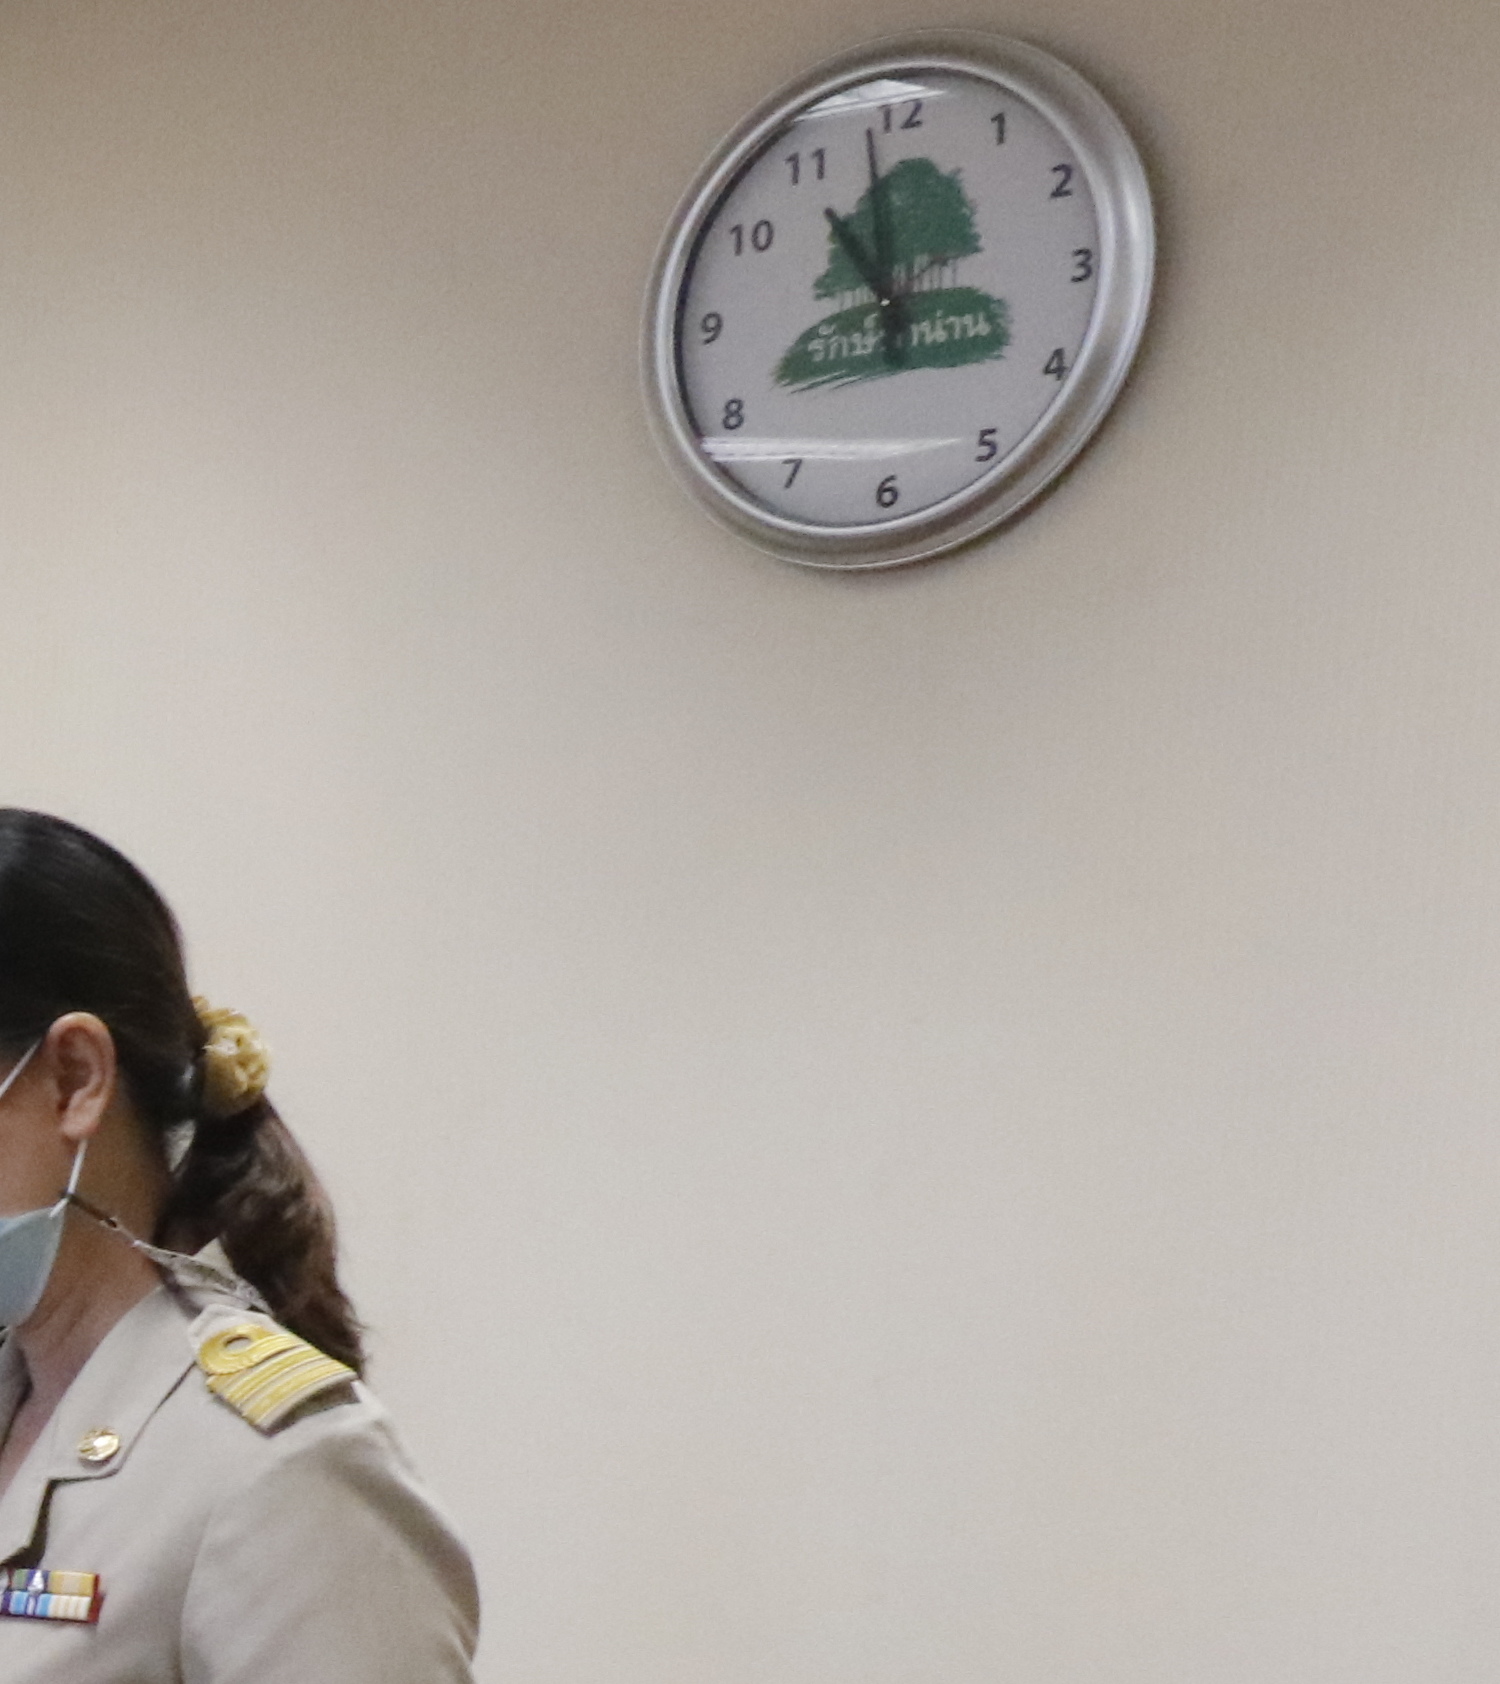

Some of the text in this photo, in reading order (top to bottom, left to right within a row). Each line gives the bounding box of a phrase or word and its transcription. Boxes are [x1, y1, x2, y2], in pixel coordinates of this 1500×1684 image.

[881, 100, 922, 133] 12
[991, 112, 1005, 144] 1
[785, 148, 825, 185] 11
[1051, 163, 1074, 198] 2
[729, 220, 774, 255] 10
[1071, 248, 1093, 283] 3
[700, 312, 723, 345] 9
[1043, 348, 1068, 380] 4
[722, 399, 744, 430] 8
[976, 428, 997, 462] 5
[782, 459, 802, 489] 7
[876, 476, 899, 508] 6
